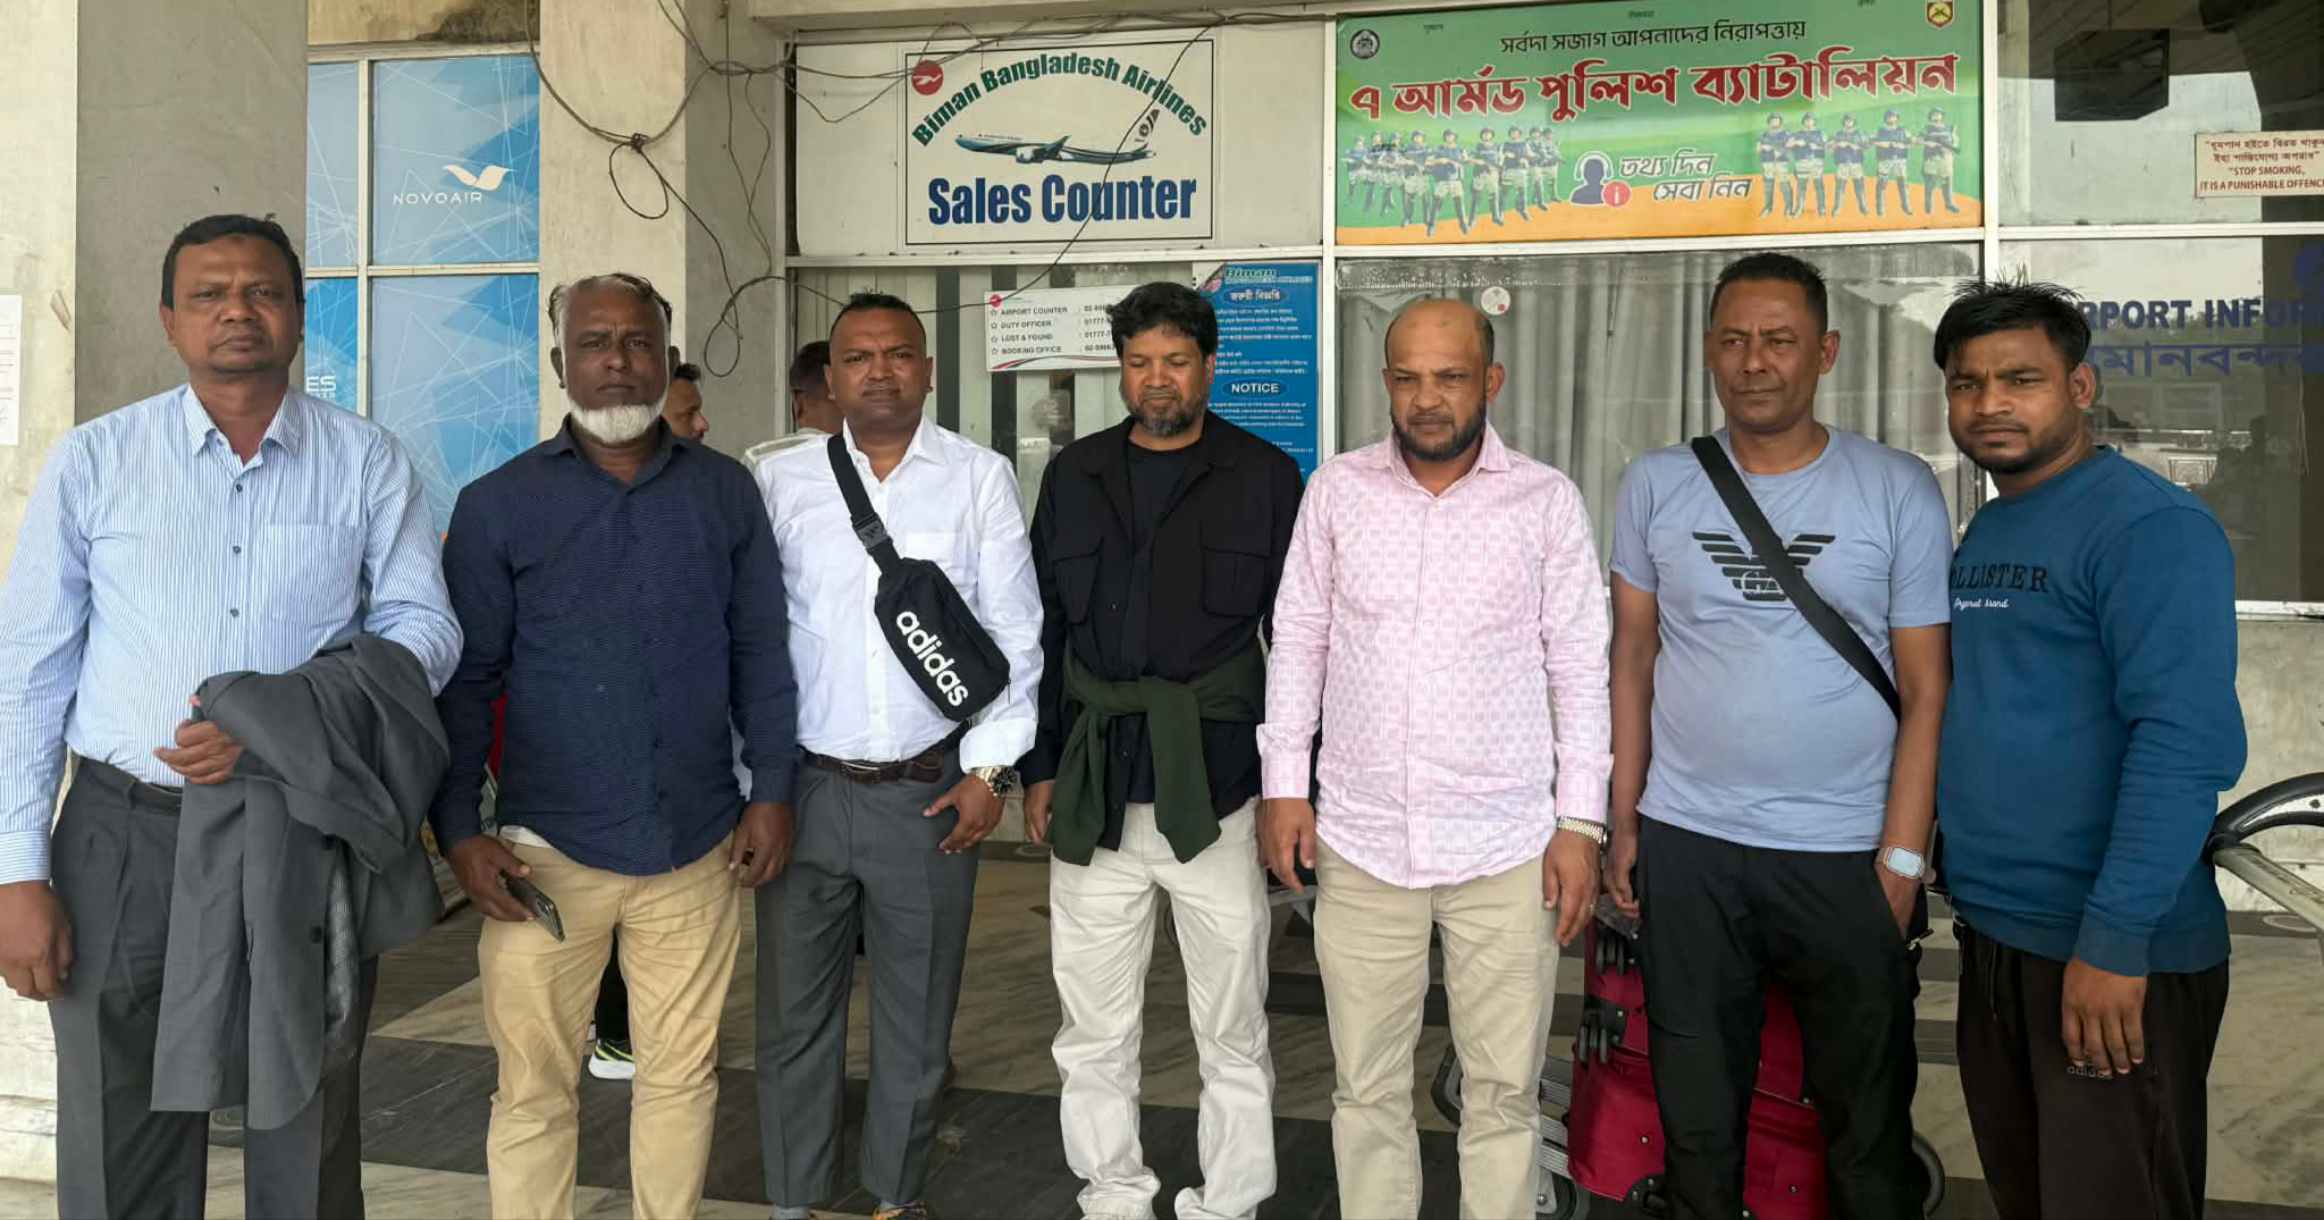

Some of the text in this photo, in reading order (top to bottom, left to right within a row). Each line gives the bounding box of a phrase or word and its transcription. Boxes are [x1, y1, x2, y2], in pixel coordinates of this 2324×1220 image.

[1501, 19, 1806, 54] সর্বদা সজাগ আপনাদের নিরাপত্তায়
[1351, 45, 1959, 122] ৭ আর্মড পুলিশ ব্যাটালিয়ন
[911, 52, 1208, 147] Biman Bangladesh Airlines
[1619, 147, 1717, 179] তথ্য দিন
[392, 192, 483, 206] NOVOAIR
[928, 174, 1197, 225] Sales Counter
[1653, 172, 1753, 201] সেবা নিন
[2200, 181, 2208, 191] IT
[2210, 180, 2218, 190] IS
[2219, 181, 2226, 190] A
[2227, 179, 2285, 190] PUNISHABLE
[1021, 320, 1052, 328] OFFICER
[1033, 306, 1068, 314] COUNTER
[2082, 299, 2324, 329] RPORT INFO
[305, 376, 337, 391] ES
[1231, 383, 1280, 393] NOTICE
[896, 610, 969, 706] adidas
